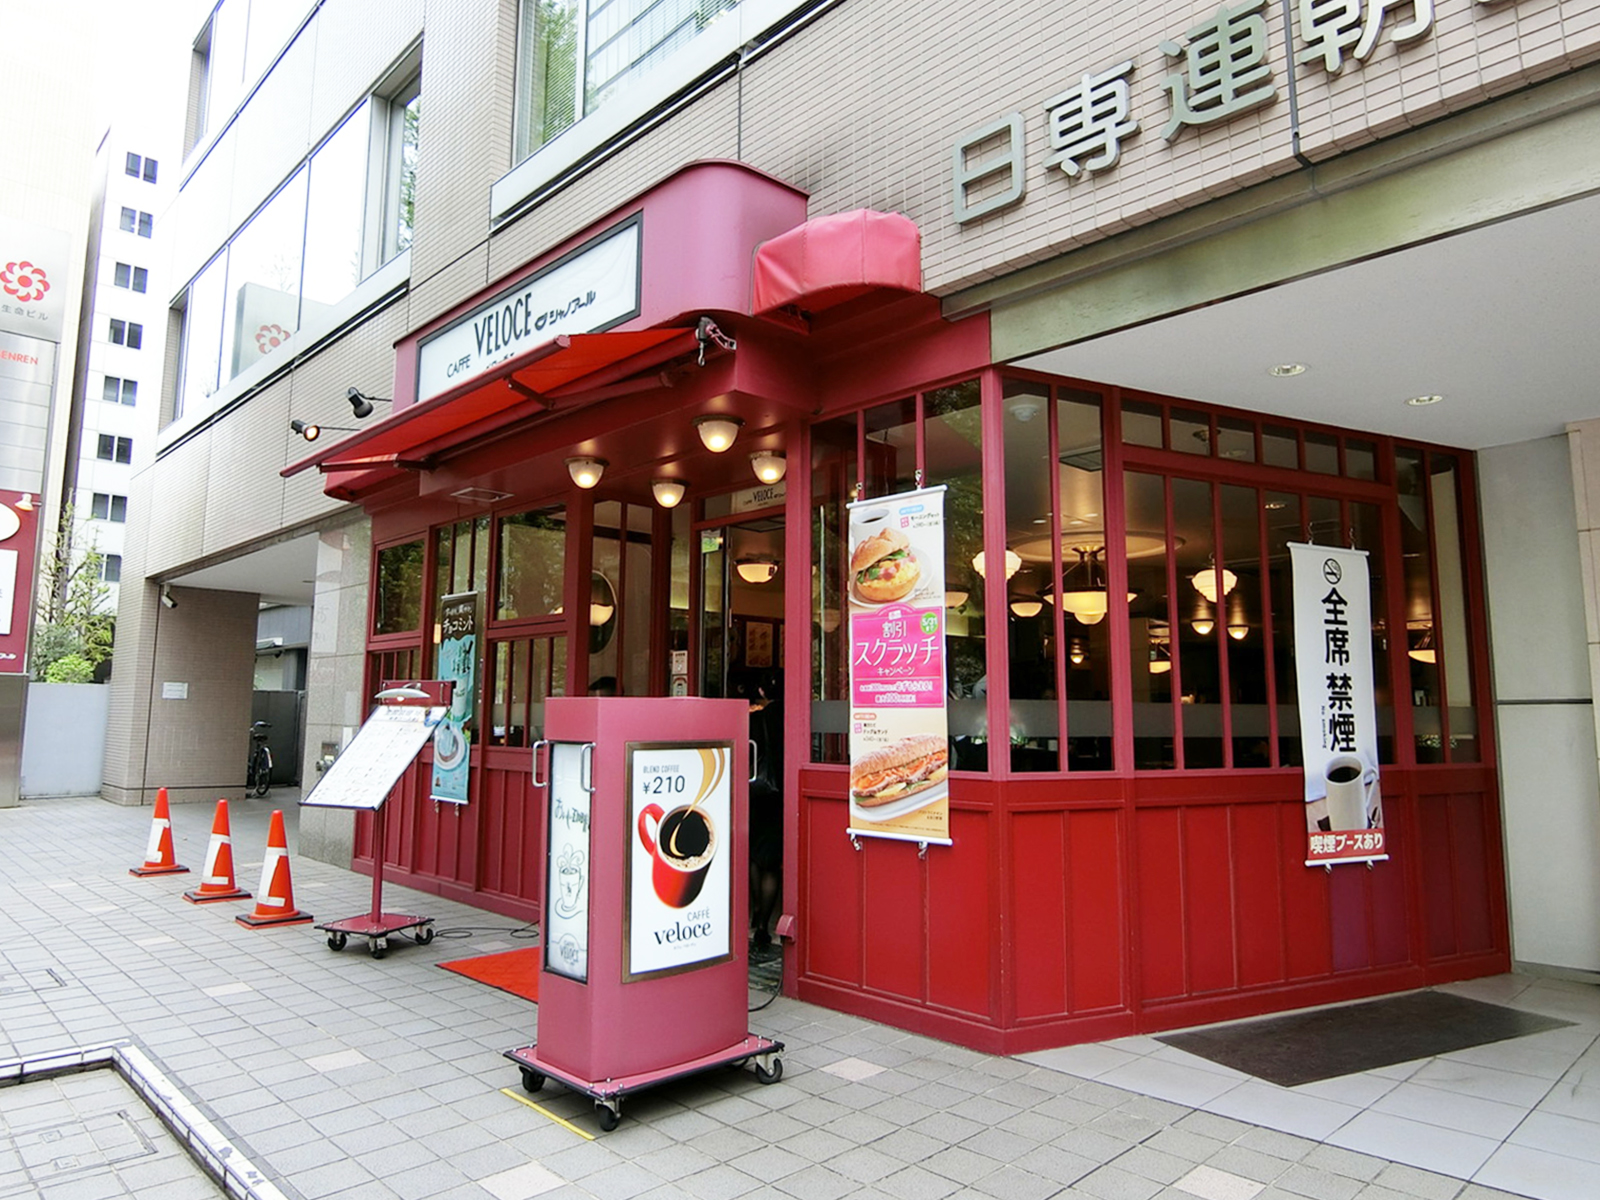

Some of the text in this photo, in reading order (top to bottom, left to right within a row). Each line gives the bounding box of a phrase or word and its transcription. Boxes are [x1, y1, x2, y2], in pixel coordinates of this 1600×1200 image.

[1, 305, 49, 321] 生命ビル
[474, 292, 533, 358] VELOCE
[548, 290, 596, 324] シャノアール
[442, 616, 474, 635] チョコミント
[882, 620, 907, 638] 割引
[854, 636, 939, 667] スクラッチ
[877, 666, 915, 676] キャンペーン
[1321, 587, 1357, 753] 全席禁煙
[643, 764, 680, 774] BLEND COFFEE
[643, 774, 686, 795] ¥210
[1309, 833, 1383, 855] 喫煙ブースあり
[653, 921, 713, 945] veloce
